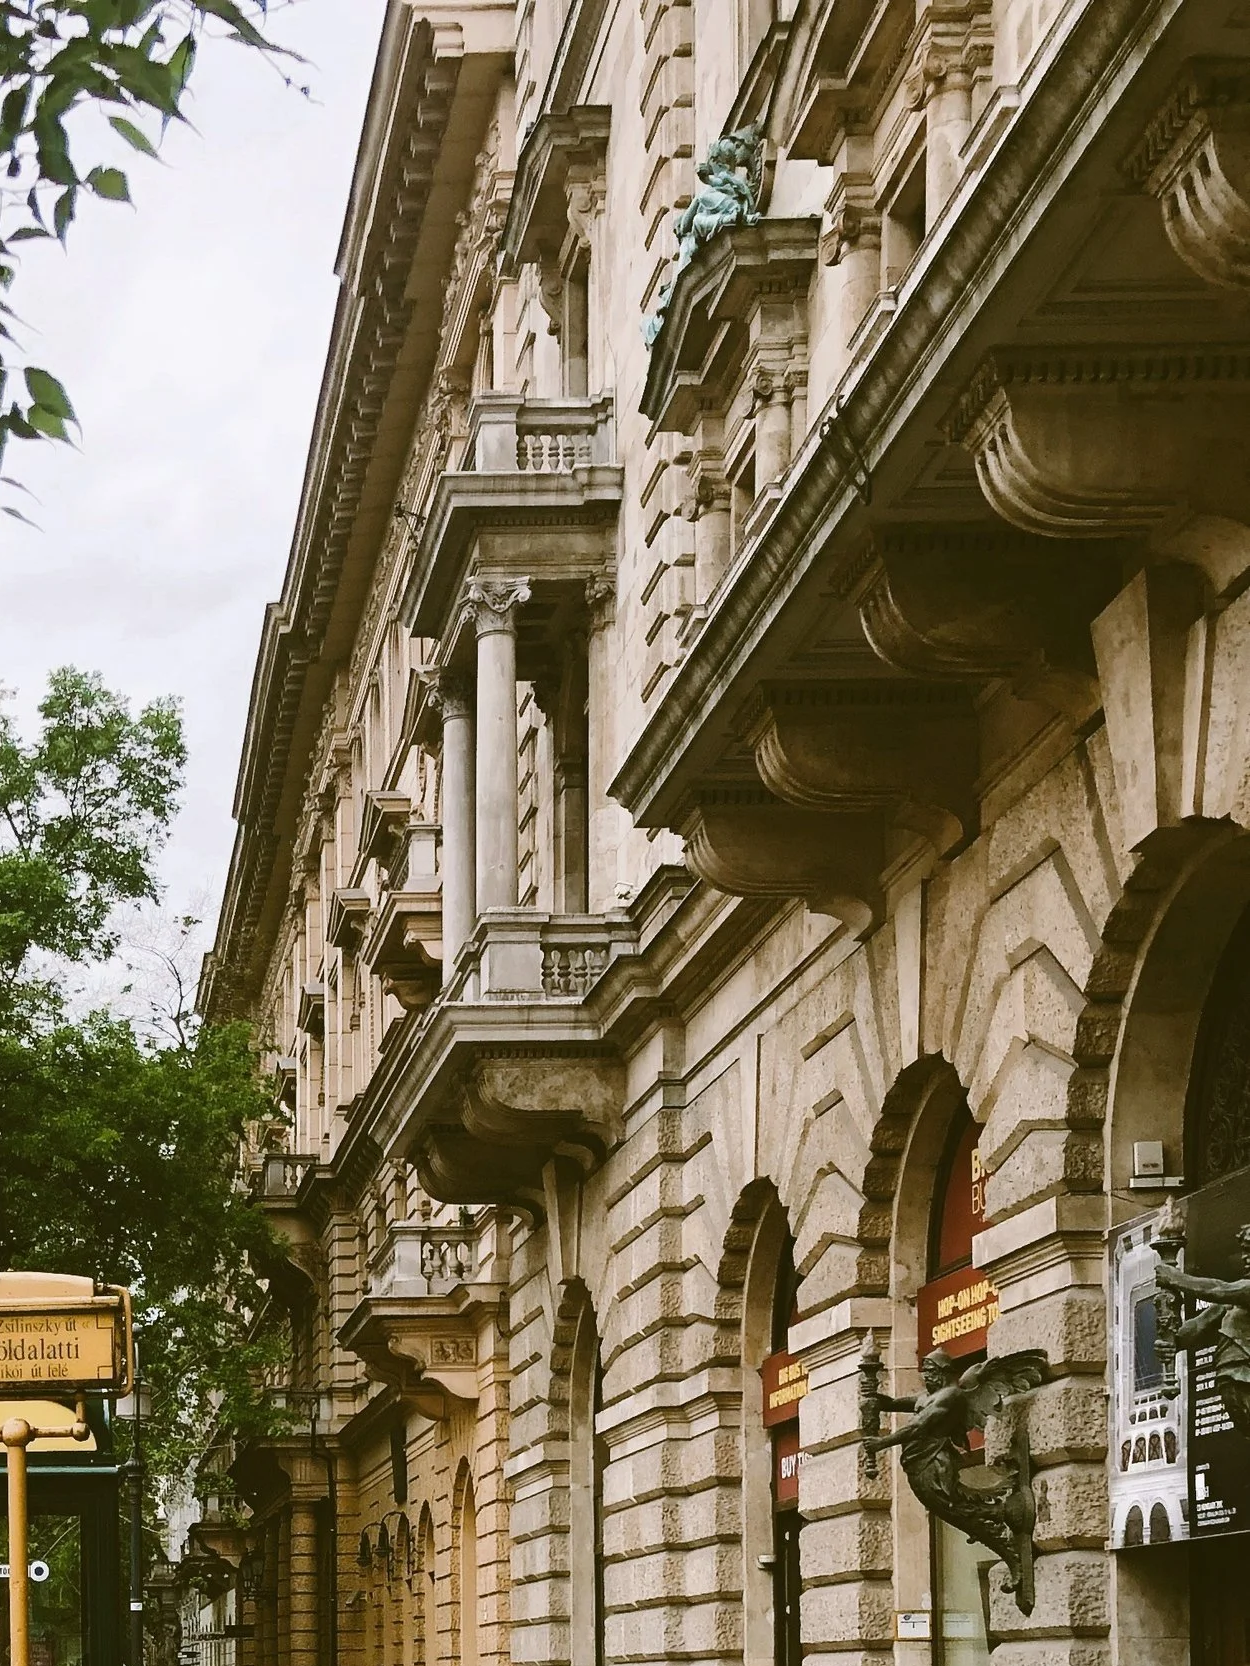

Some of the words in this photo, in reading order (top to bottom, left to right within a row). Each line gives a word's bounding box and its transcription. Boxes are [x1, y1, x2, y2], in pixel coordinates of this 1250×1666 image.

[937, 1287, 971, 1320] HOP-ON
[65, 1318, 77, 1332] út
[932, 1306, 987, 1346] SIGHTSEEING
[31, 1363, 42, 1379] út
[47, 1362, 69, 1379] felé
[781, 1453, 796, 1479] BUY
